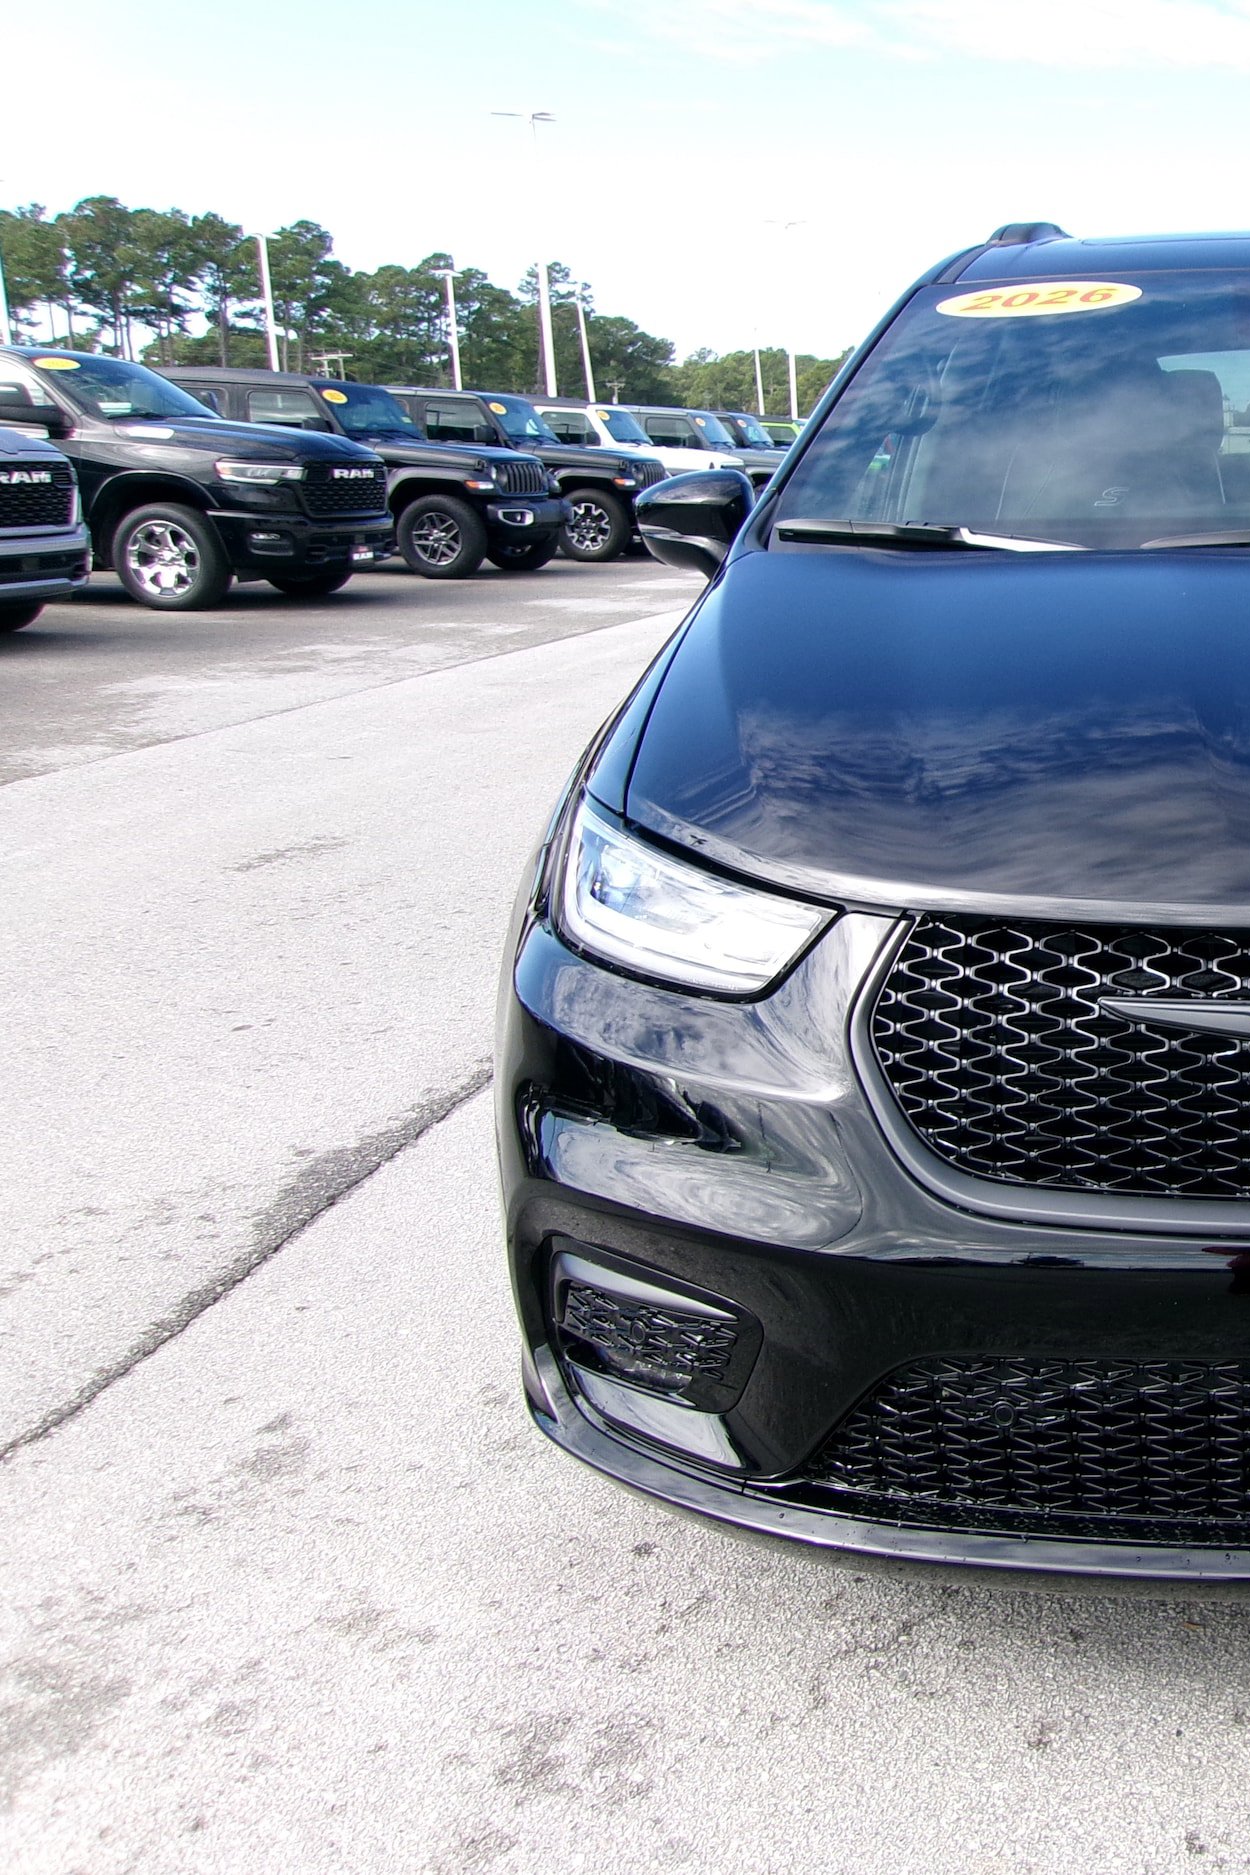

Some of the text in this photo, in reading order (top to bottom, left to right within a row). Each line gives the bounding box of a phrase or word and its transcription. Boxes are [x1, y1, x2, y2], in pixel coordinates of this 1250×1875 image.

[960, 288, 1118, 311] 2026
[0, 471, 52, 484] RAM
[333, 468, 374, 479] RAM
